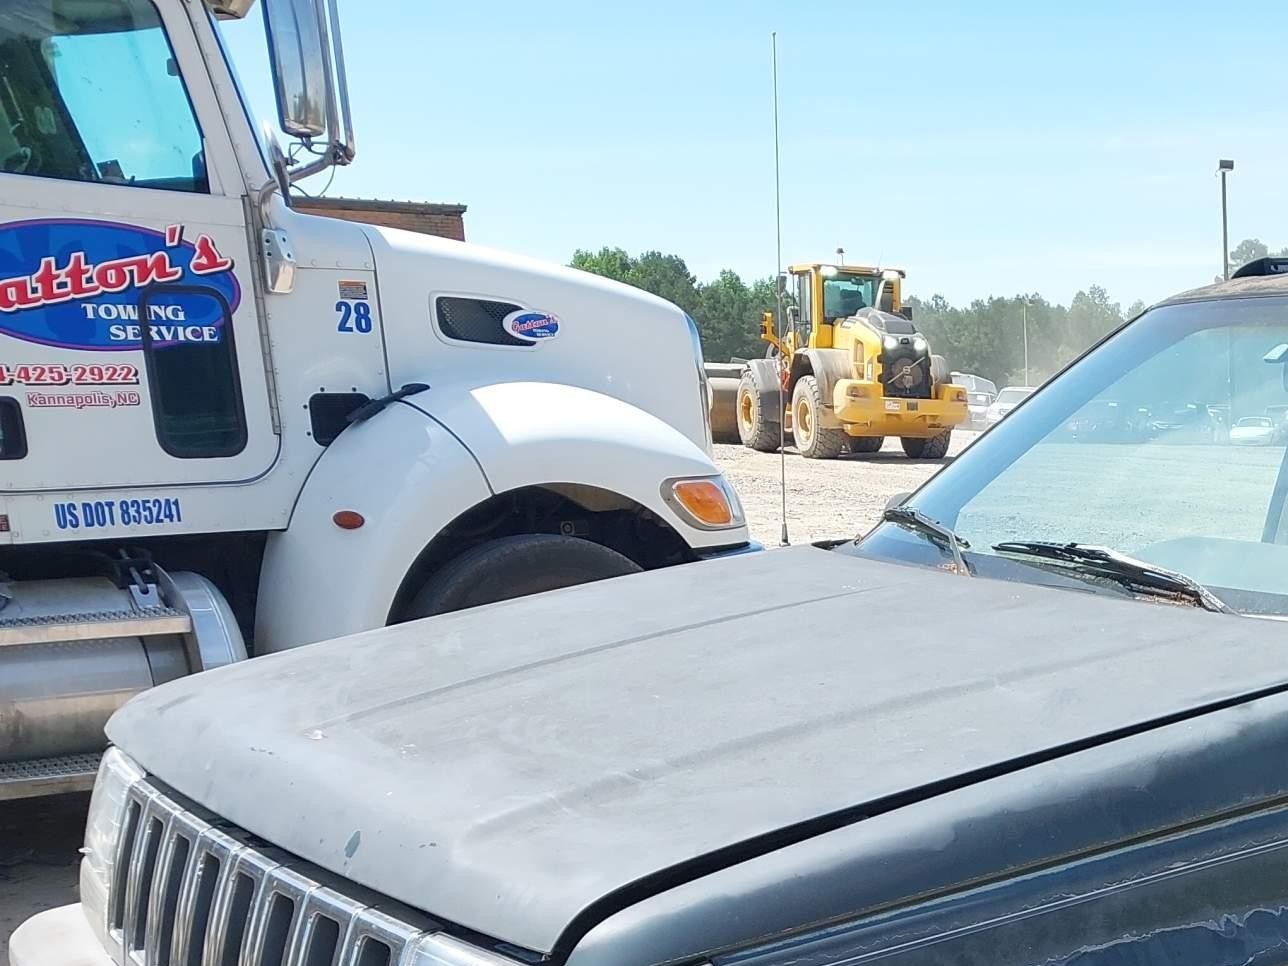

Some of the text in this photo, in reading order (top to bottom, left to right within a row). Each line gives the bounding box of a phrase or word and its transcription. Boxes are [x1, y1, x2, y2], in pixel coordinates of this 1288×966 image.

[81, 303, 185, 321] TOWNG
[335, 301, 372, 333] 28
[27, 391, 139, 408] Kannapolis, NC
[55, 499, 182, 529] US DOT 835241
